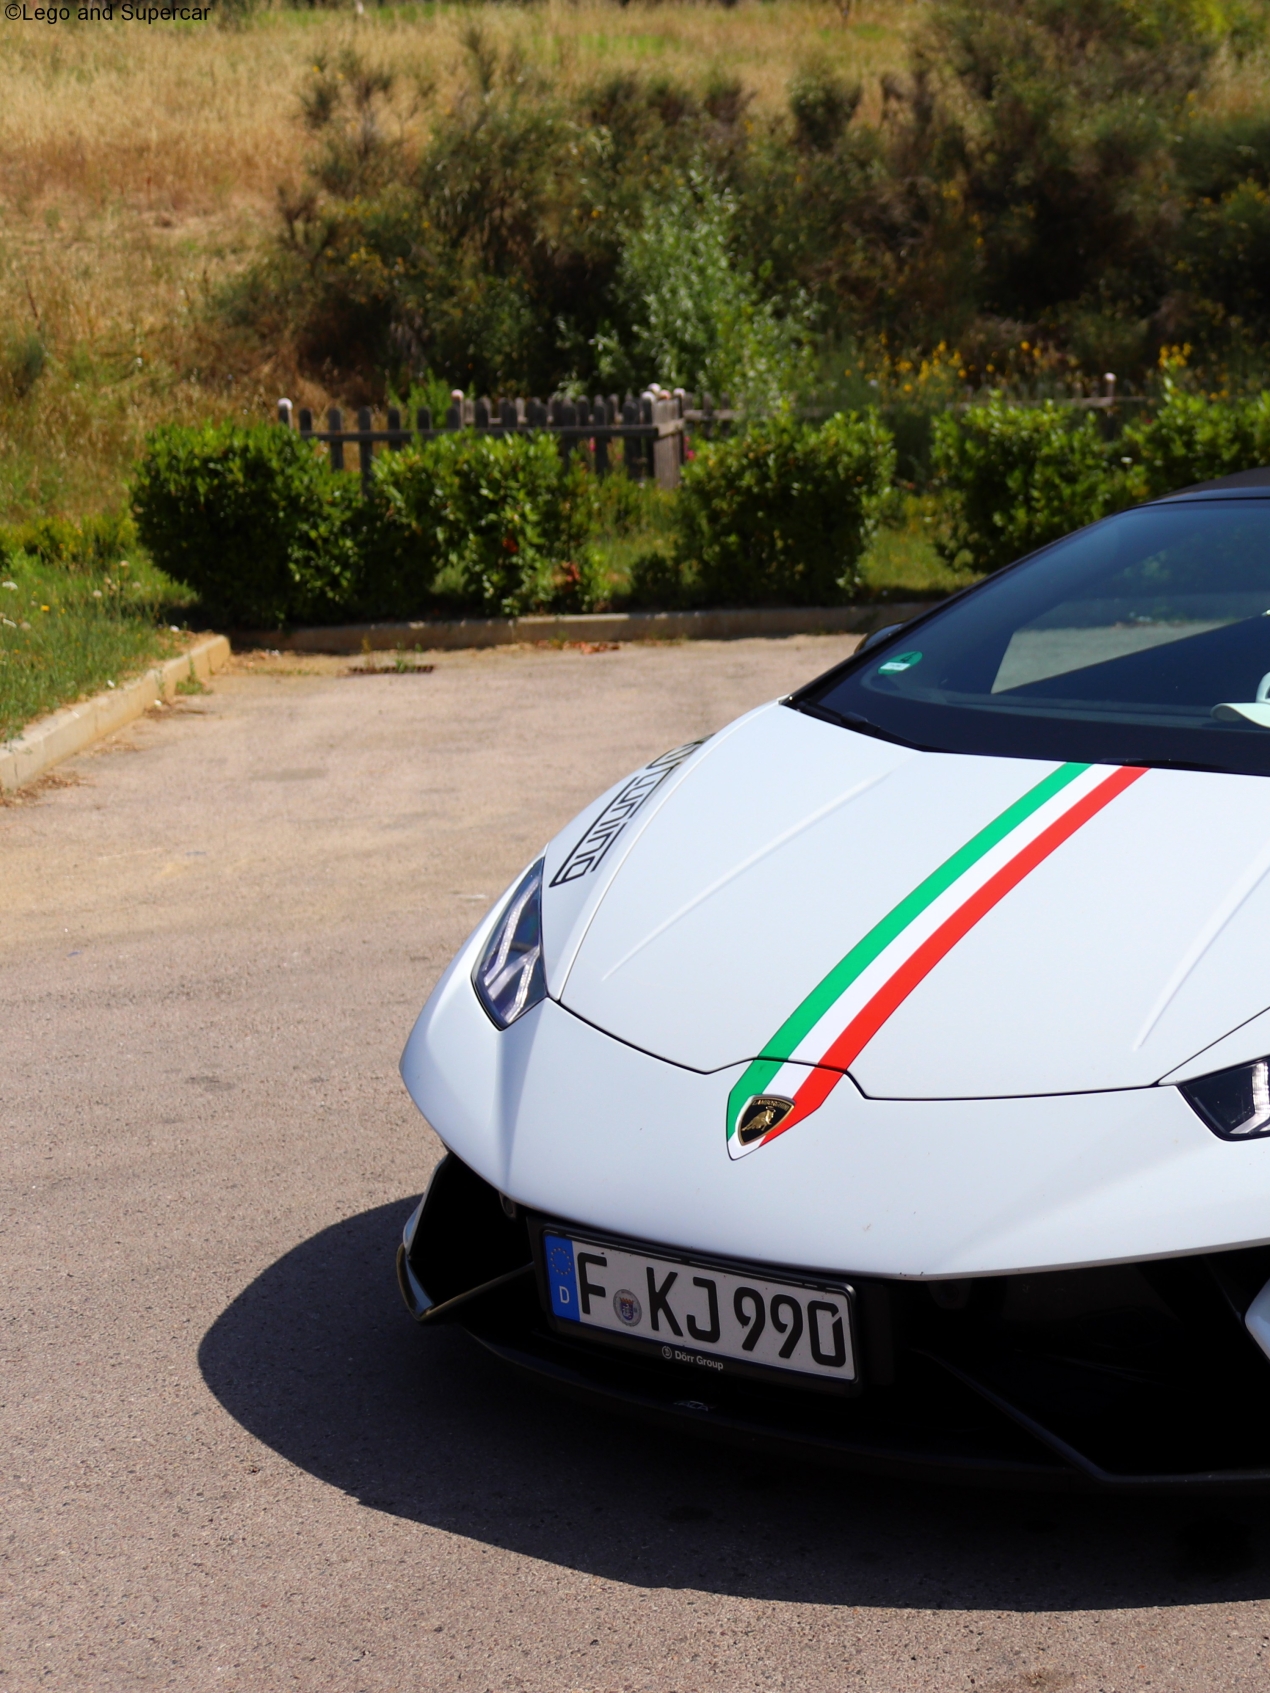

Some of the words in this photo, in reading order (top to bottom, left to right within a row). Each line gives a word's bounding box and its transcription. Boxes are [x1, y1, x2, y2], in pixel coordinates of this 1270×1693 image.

[559, 1286, 570, 1304] D
[577, 1252, 607, 1315] F
[733, 1287, 847, 1368] 990
[674, 1350, 695, 1363] Dörr
[696, 1355, 723, 1371] Group
